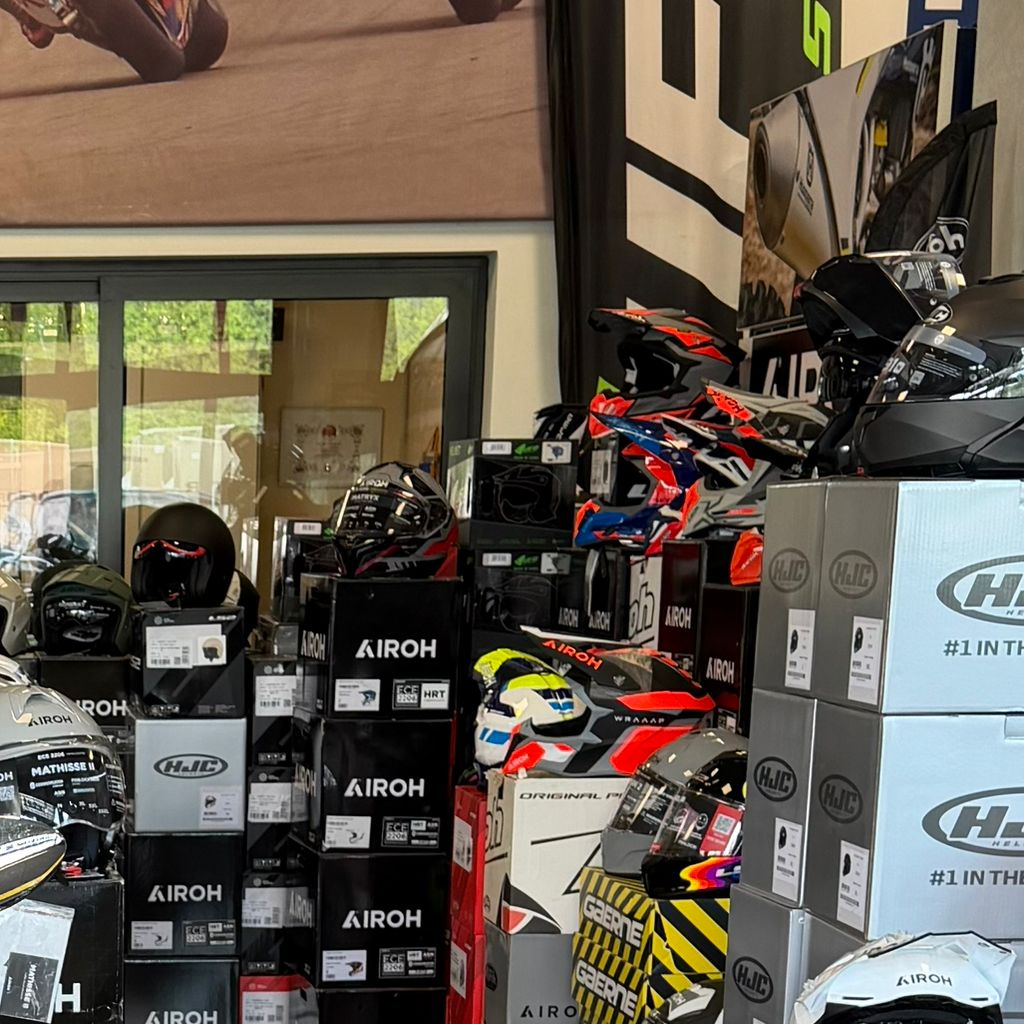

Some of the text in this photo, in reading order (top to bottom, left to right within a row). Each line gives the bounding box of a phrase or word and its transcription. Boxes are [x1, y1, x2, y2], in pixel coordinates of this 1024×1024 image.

[775, 558, 807, 582] HJC
[833, 562, 872, 588] HJC
[558, 606, 579, 628] AIROH
[665, 605, 693, 630] AIROH
[301, 629, 326, 661] AIROH
[355, 638, 437, 659] AIROH
[542, 639, 603, 671] AIROH
[943, 640, 971, 656] #1
[977, 640, 998, 656] IN
[706, 656, 735, 684] AIROH
[423, 690, 446, 700] HRT
[29, 715, 73, 727] AIROH
[614, 715, 665, 724] WRAAAP
[31, 762, 85, 777] MATHISSE
[164, 760, 218, 773] HJC
[344, 778, 425, 797] AIROH
[756, 765, 790, 793] HJC
[519, 792, 602, 800] ORIGINAL
[822, 786, 858, 813] HJC
[930, 869, 958, 886] #1
[963, 870, 985, 885] IN
[148, 884, 222, 902] AIROH
[289, 890, 313, 929] AIROH
[342, 909, 422, 929] AIROH
[736, 968, 770, 997] HJC
[896, 973, 953, 987] AIROH
